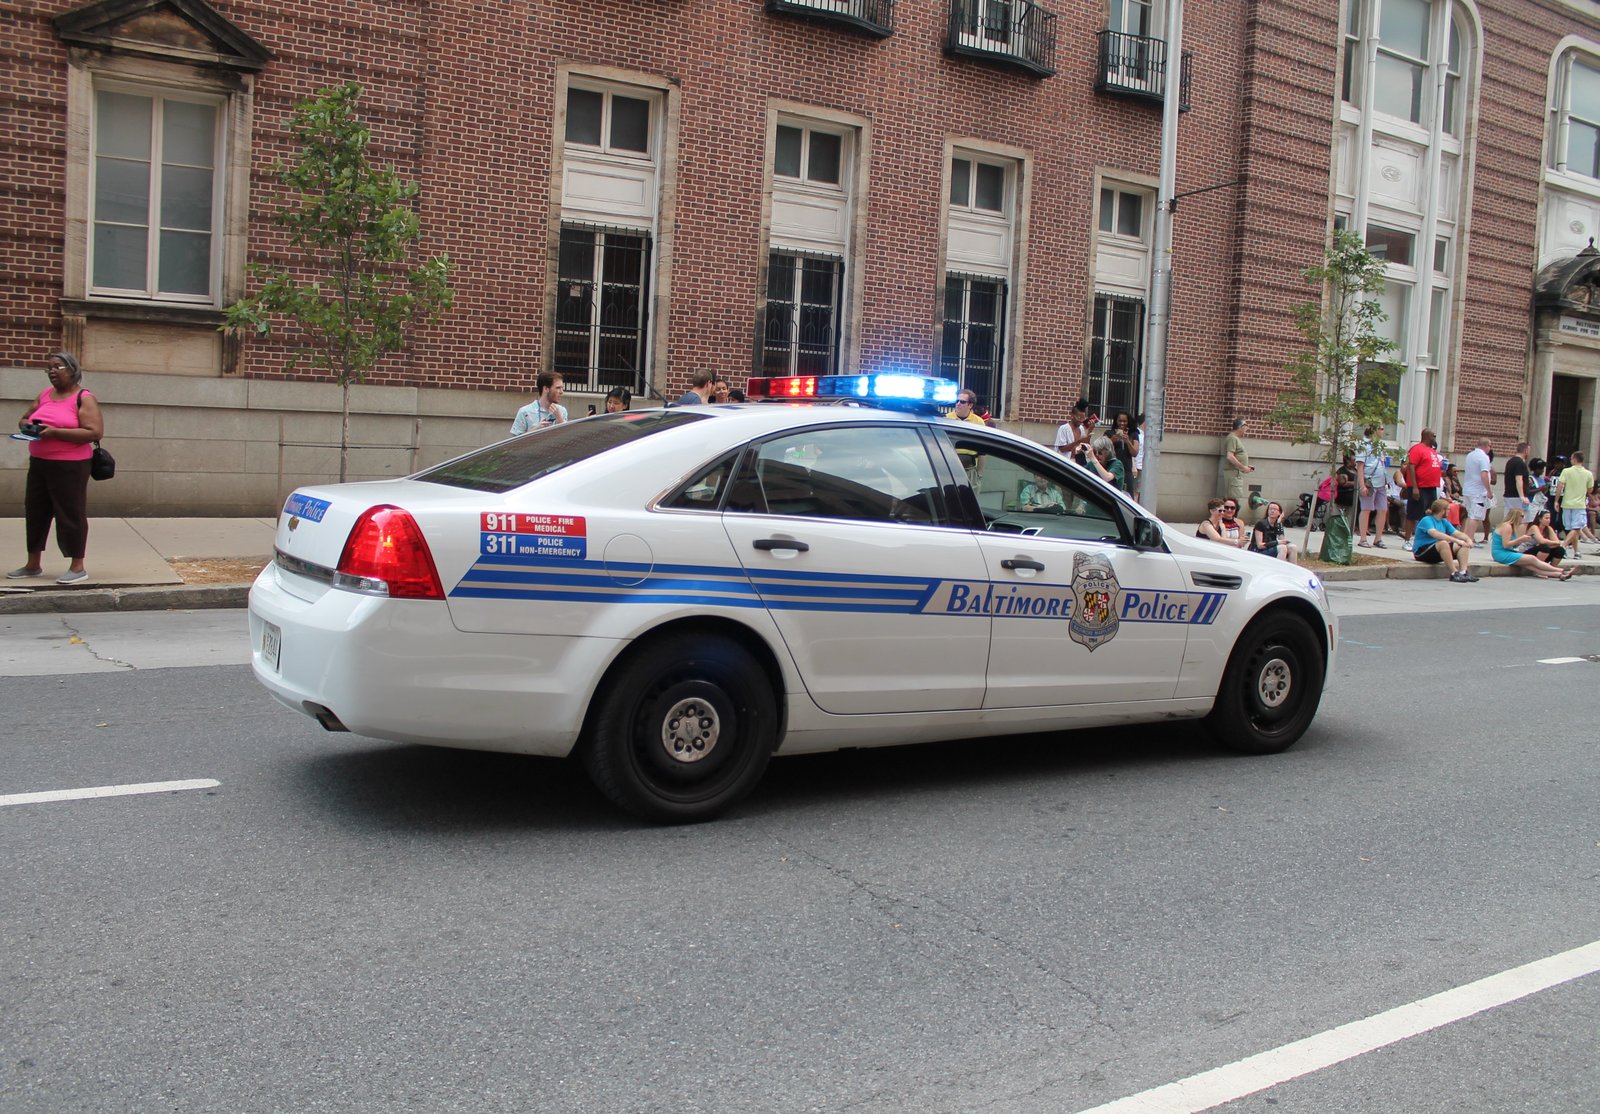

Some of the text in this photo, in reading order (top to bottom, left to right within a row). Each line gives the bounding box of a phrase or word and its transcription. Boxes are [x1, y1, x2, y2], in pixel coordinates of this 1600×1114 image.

[486, 513, 517, 531] 911
[526, 515, 551, 524] POLICE
[558, 517, 574, 526] FIRE
[534, 524, 567, 534] MEDICAL
[486, 534, 517, 554] 311
[538, 537, 563, 547] POLICE
[519, 546, 581, 557] NON-EMERGENCY
[1083, 581, 1110, 590] POLICE
